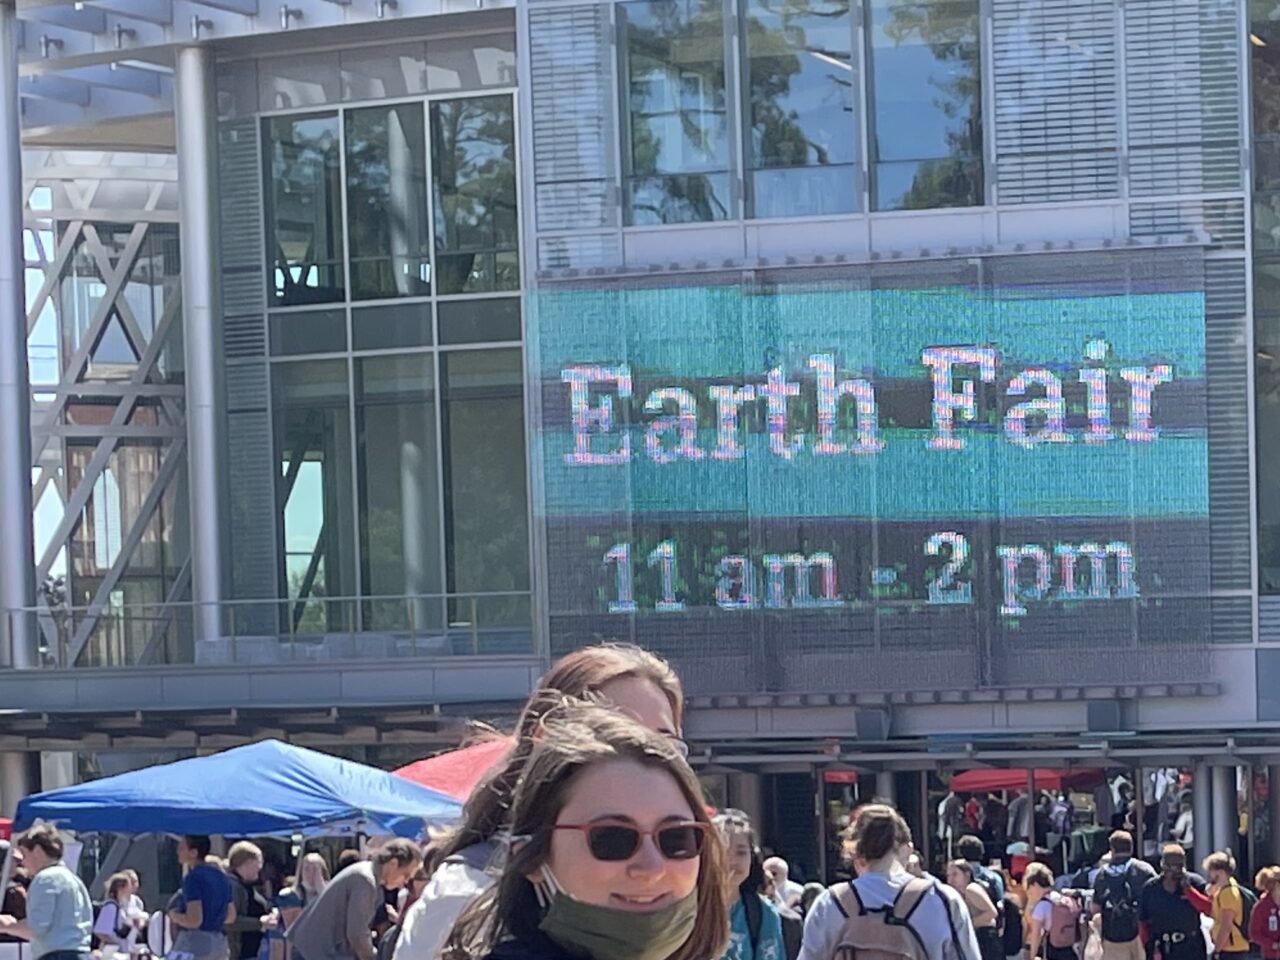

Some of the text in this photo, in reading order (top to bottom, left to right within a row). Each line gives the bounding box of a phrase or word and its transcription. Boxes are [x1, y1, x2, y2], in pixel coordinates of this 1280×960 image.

[561, 338, 1173, 465] Earth Fair
[603, 539, 687, 613] 11
[714, 551, 845, 611] am
[923, 531, 973, 604] 2
[996, 541, 1140, 616] pm
